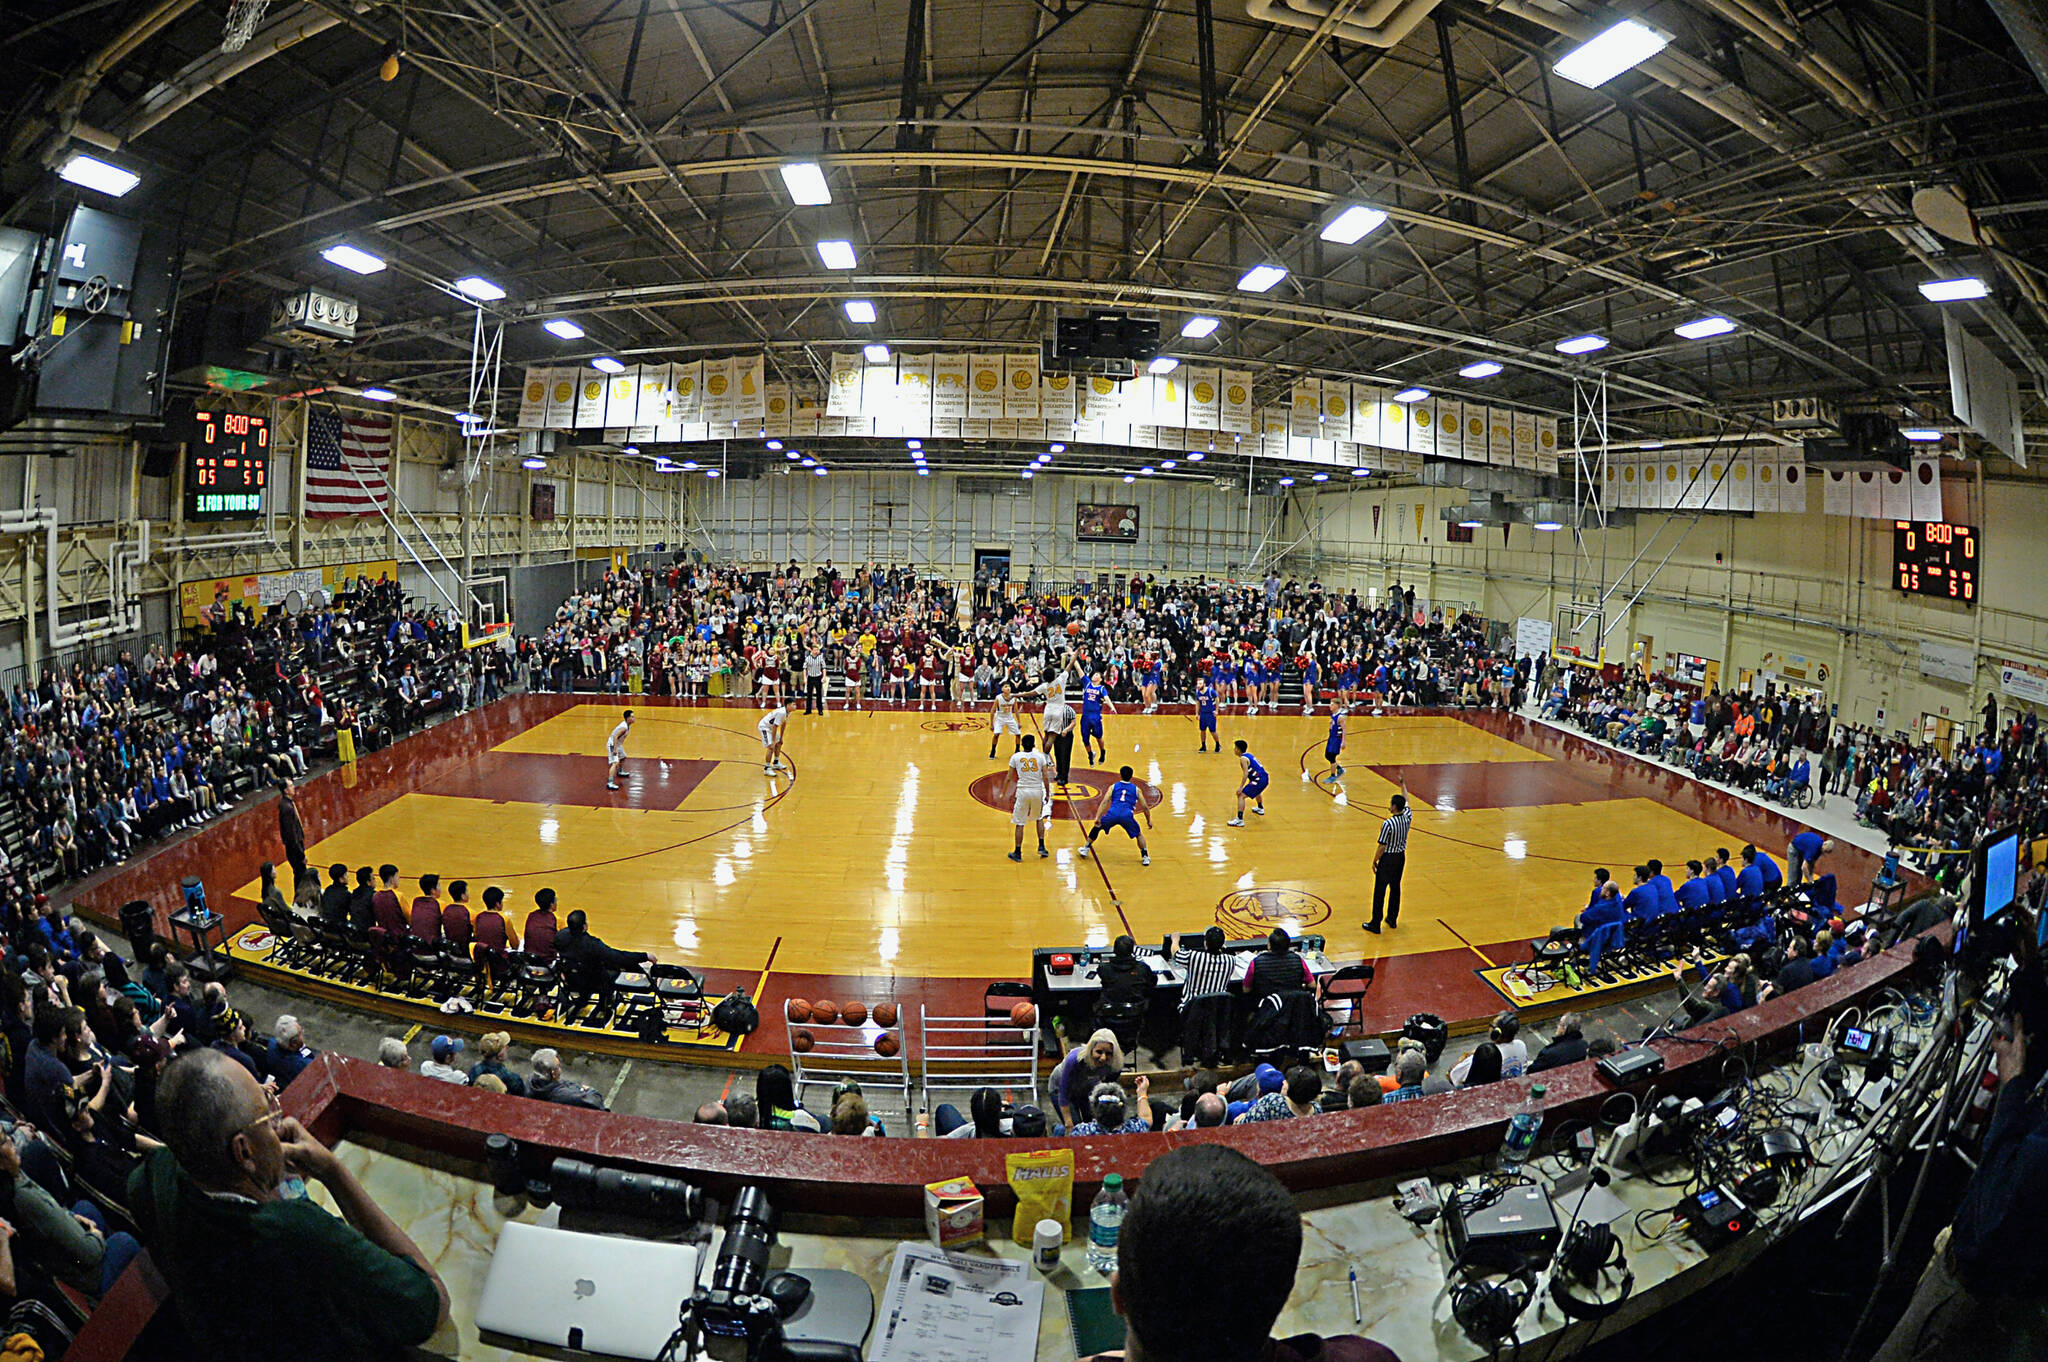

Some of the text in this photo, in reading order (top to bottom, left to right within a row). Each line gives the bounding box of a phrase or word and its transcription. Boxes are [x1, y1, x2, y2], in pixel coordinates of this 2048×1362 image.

[205, 423, 216, 444] 0
[224, 414, 249, 435] 8:00
[258, 427, 268, 447] 0
[199, 468, 216, 486] 0 5
[243, 469, 264, 486] 5 0
[205, 494, 223, 512] FOR
[223, 494, 247, 511] YOUR
[1906, 531, 1915, 551] 0
[1926, 522, 1952, 544] 8:00
[1964, 537, 1974, 558] 0
[1901, 572, 1919, 590] 0 5
[1949, 579, 1973, 599] 5 0
[1047, 685, 1062, 699] 24
[1020, 757, 1039, 772] 33
[1119, 789, 1127, 802] 1
[1013, 1165, 1070, 1181] HALLS
